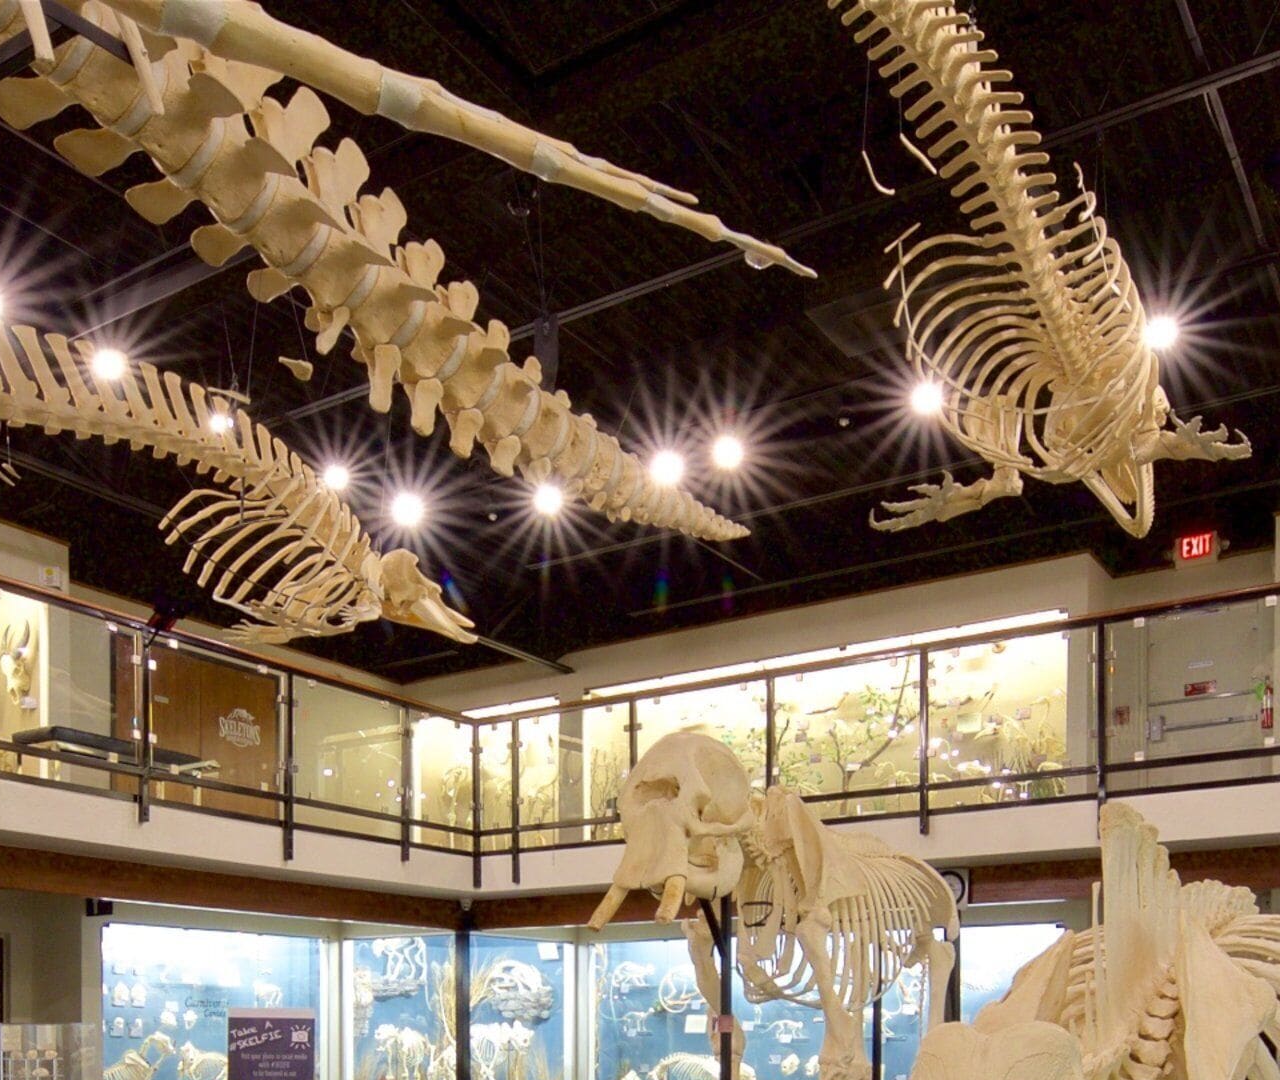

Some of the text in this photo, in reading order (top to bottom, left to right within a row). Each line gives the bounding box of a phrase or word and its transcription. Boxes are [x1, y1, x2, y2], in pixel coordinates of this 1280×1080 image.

[1182, 534, 1212, 559] EXIT
[219, 716, 261, 745] SKELETONS
[230, 1020, 274, 1039] Take A
